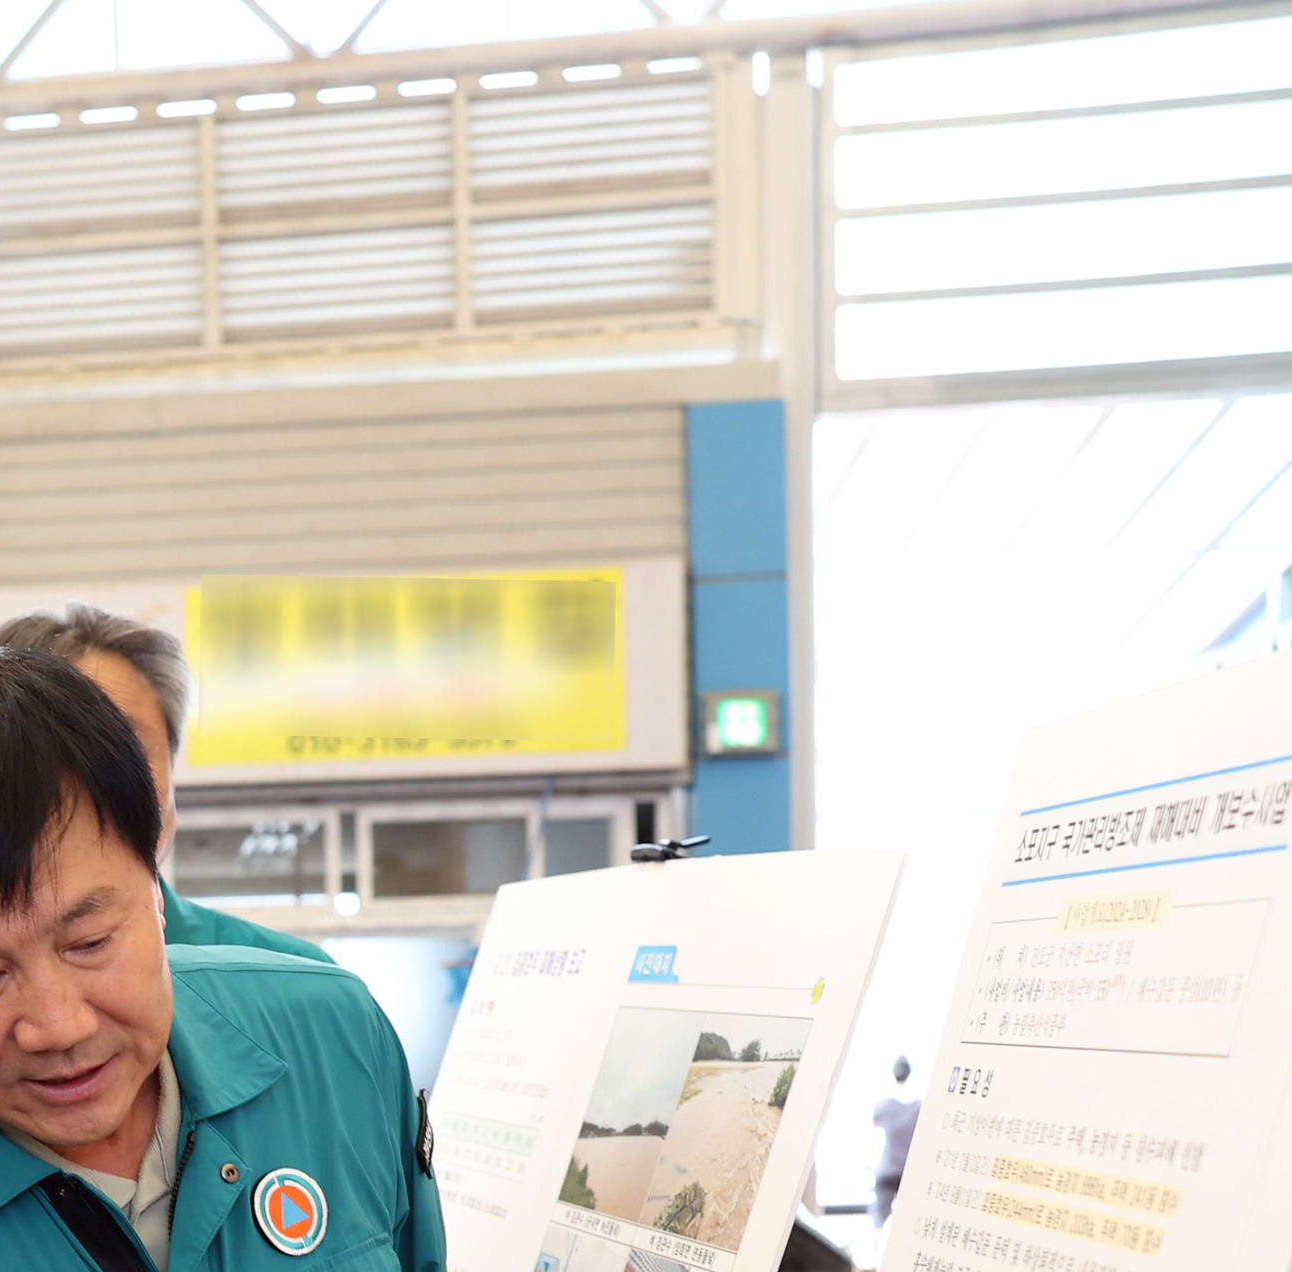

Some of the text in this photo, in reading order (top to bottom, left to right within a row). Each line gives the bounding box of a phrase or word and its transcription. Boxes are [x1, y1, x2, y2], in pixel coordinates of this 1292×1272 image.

[1012, 821, 1061, 867] 소포지구
[1057, 804, 1148, 860] 국가관리방조제
[1143, 792, 1209, 847] 재해대비
[633, 952, 674, 975] 사진대지
